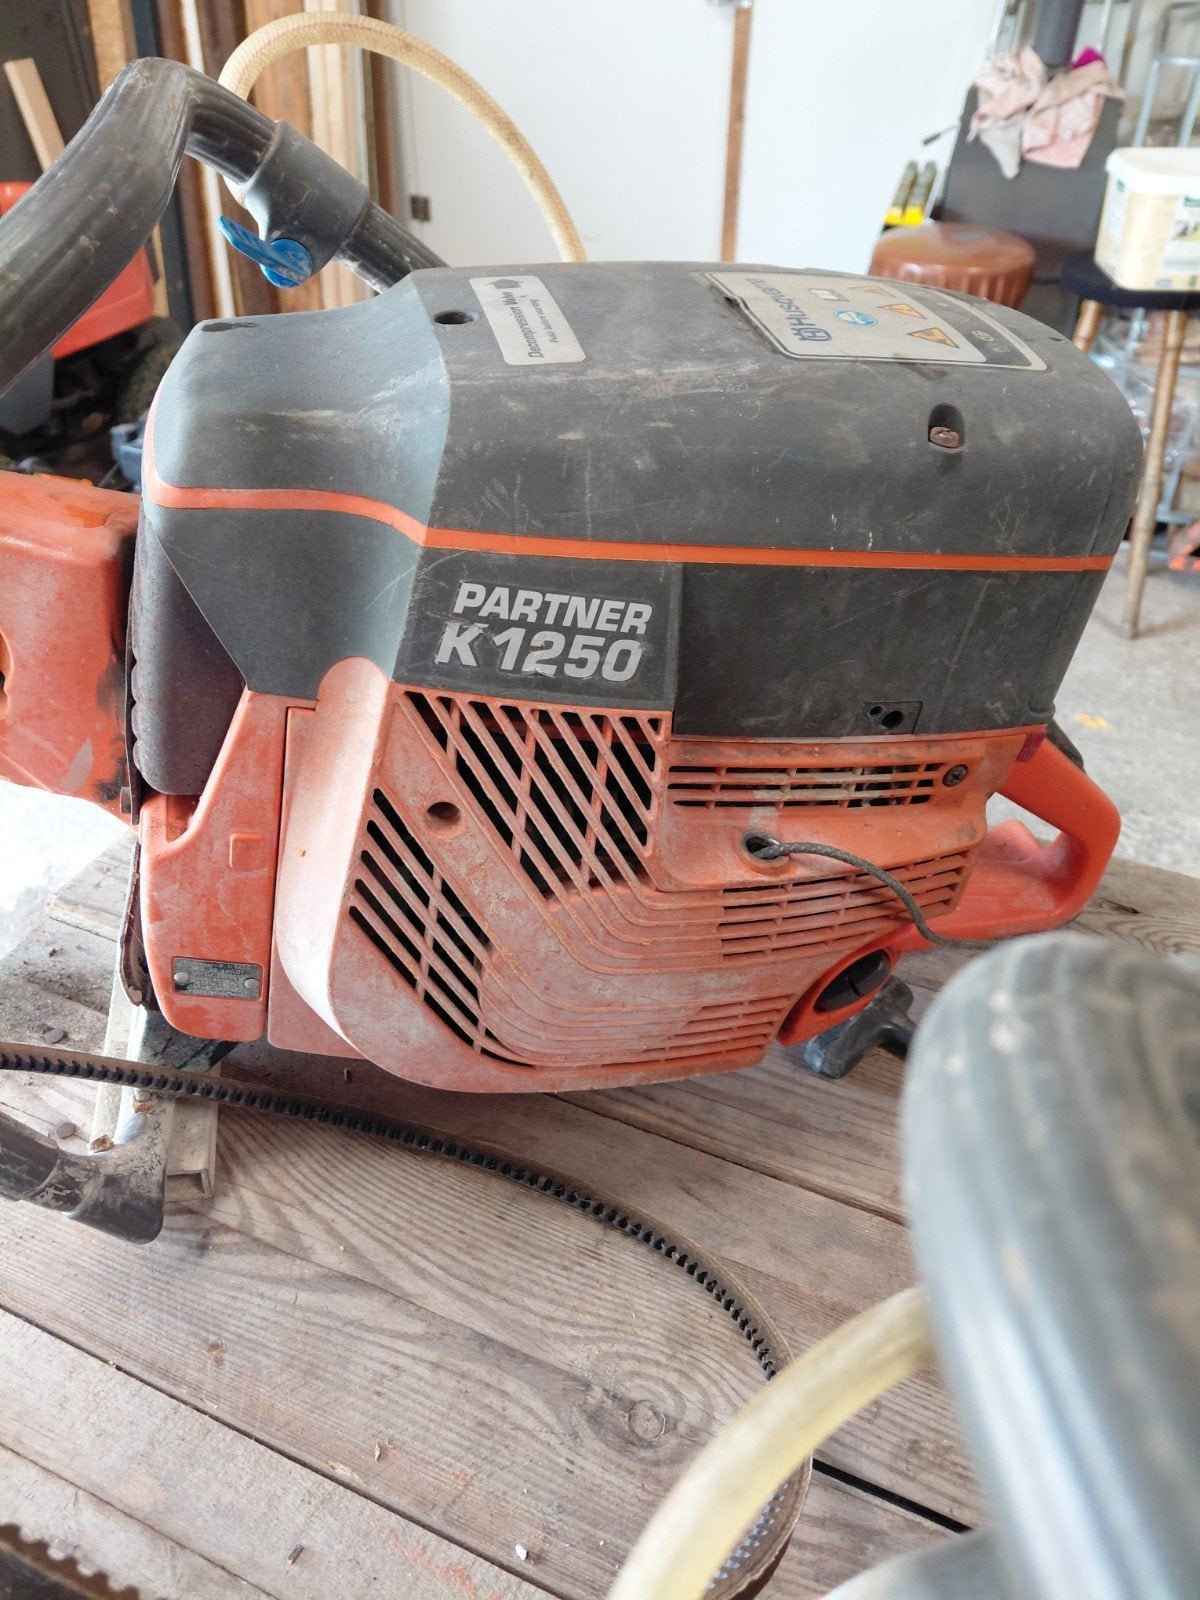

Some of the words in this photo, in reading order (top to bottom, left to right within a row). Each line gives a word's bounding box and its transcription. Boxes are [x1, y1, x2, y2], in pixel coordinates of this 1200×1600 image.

[510, 306, 544, 358] Decompression
[453, 582, 653, 634] PARTNER
[435, 621, 489, 667] K
[492, 627, 643, 682] 1250
